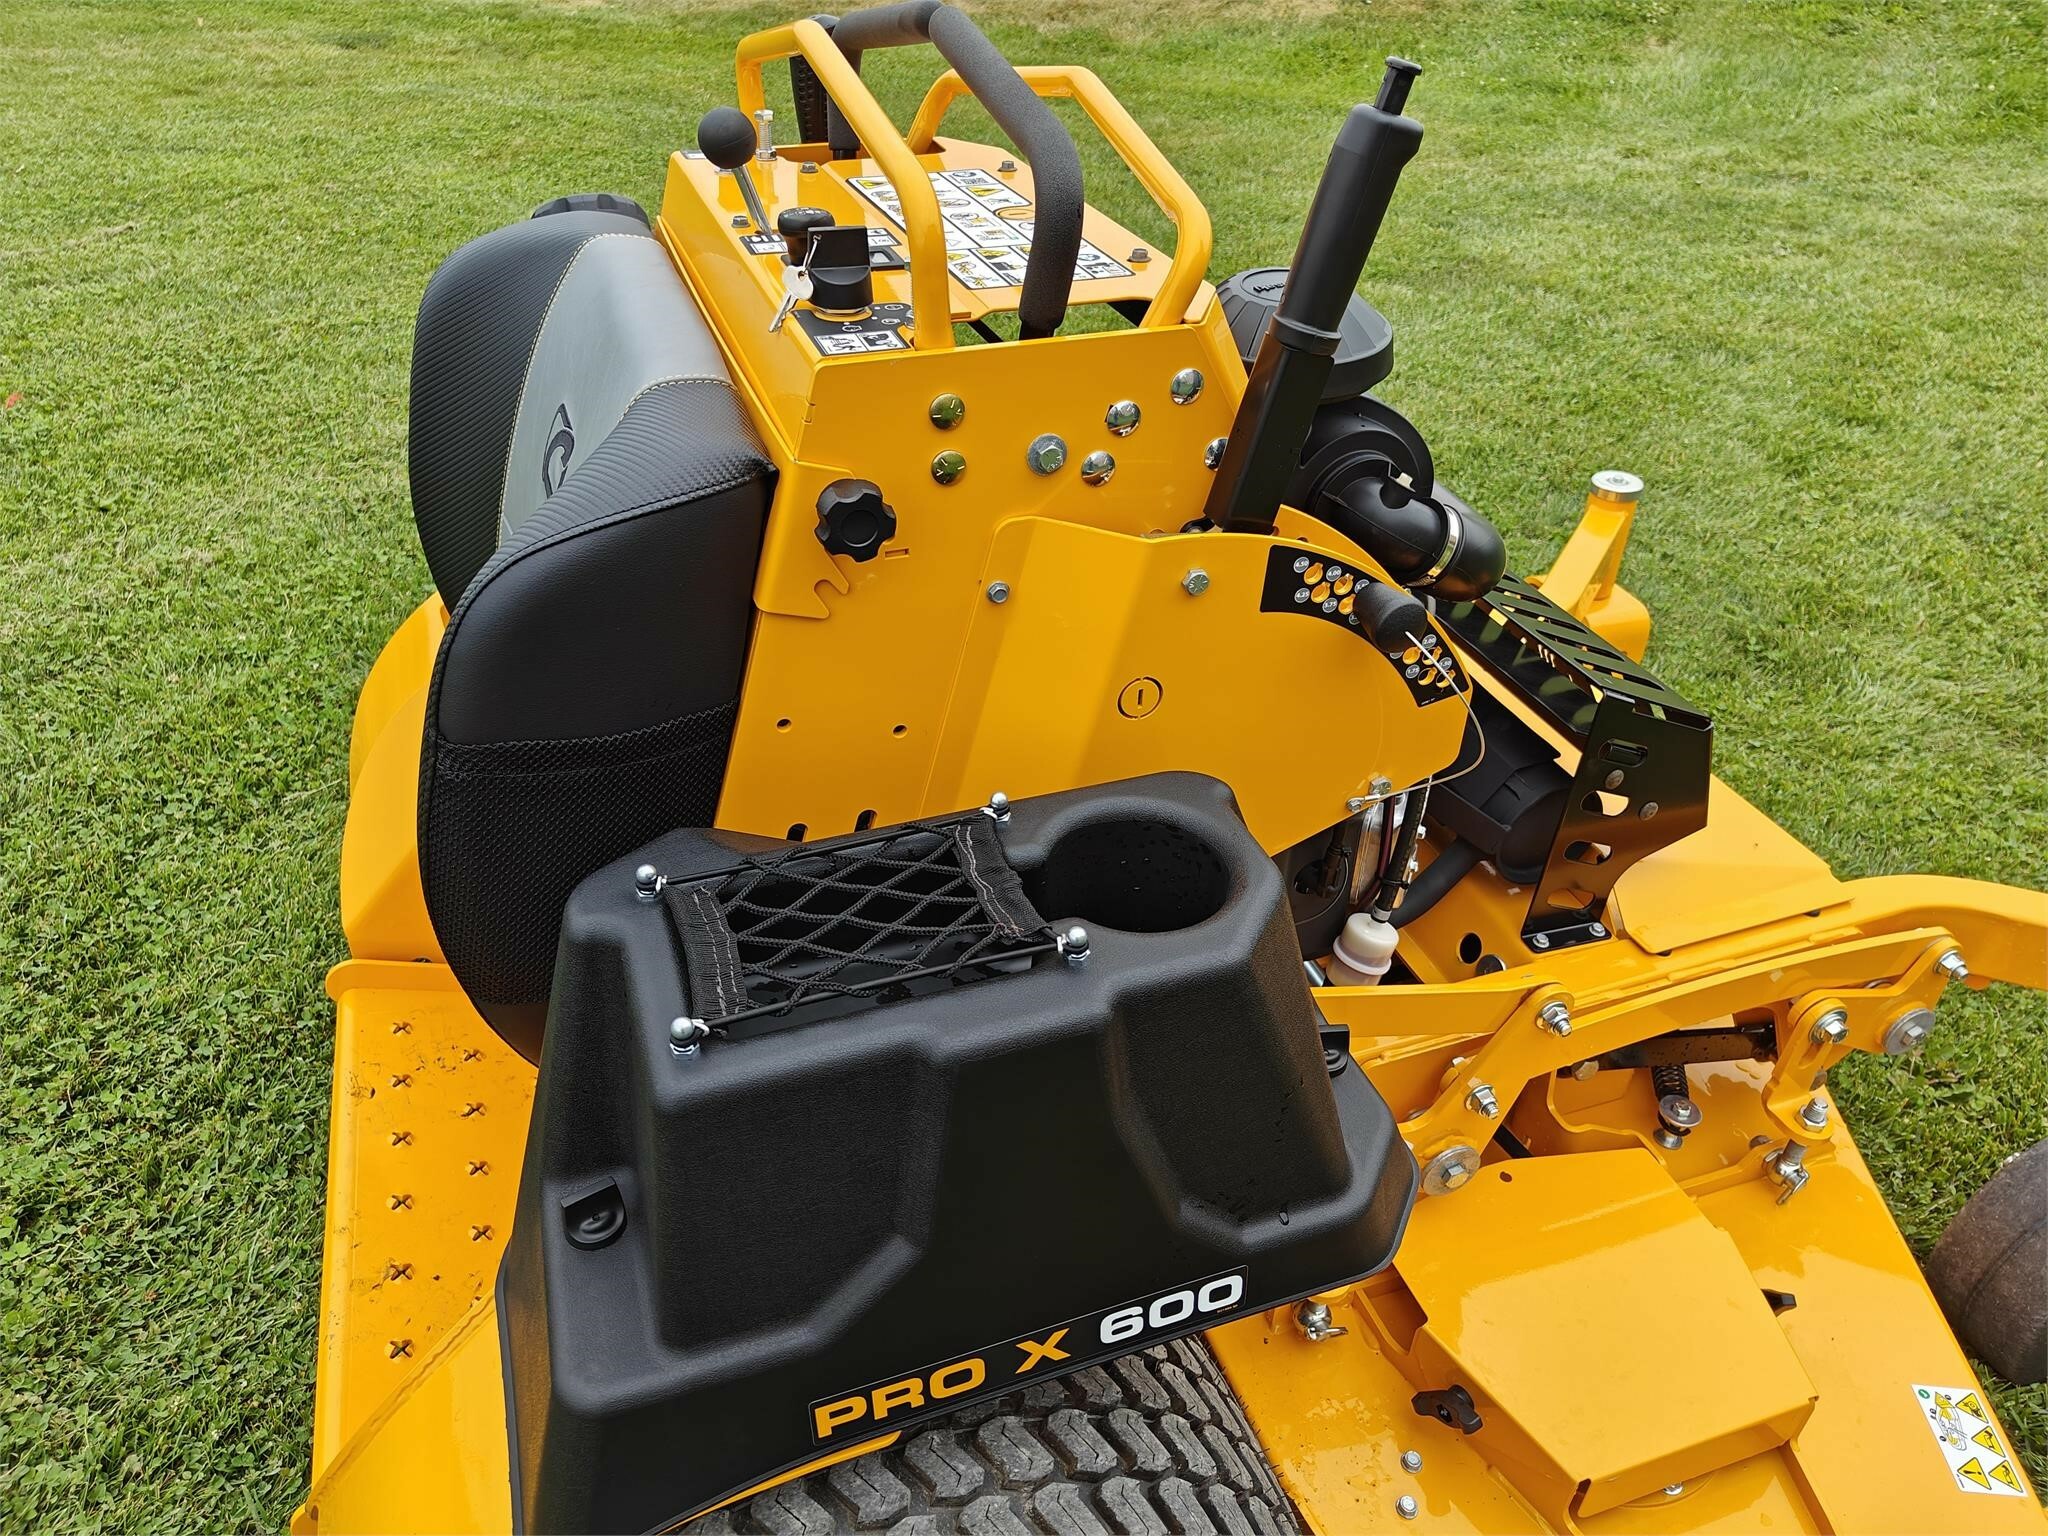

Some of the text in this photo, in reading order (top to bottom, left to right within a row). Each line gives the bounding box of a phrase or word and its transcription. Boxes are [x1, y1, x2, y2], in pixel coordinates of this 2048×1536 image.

[1295, 560, 1309, 568] 4.50
[1327, 569, 1341, 577] 4.00
[814, 1275, 1243, 1438] PRO X 600
